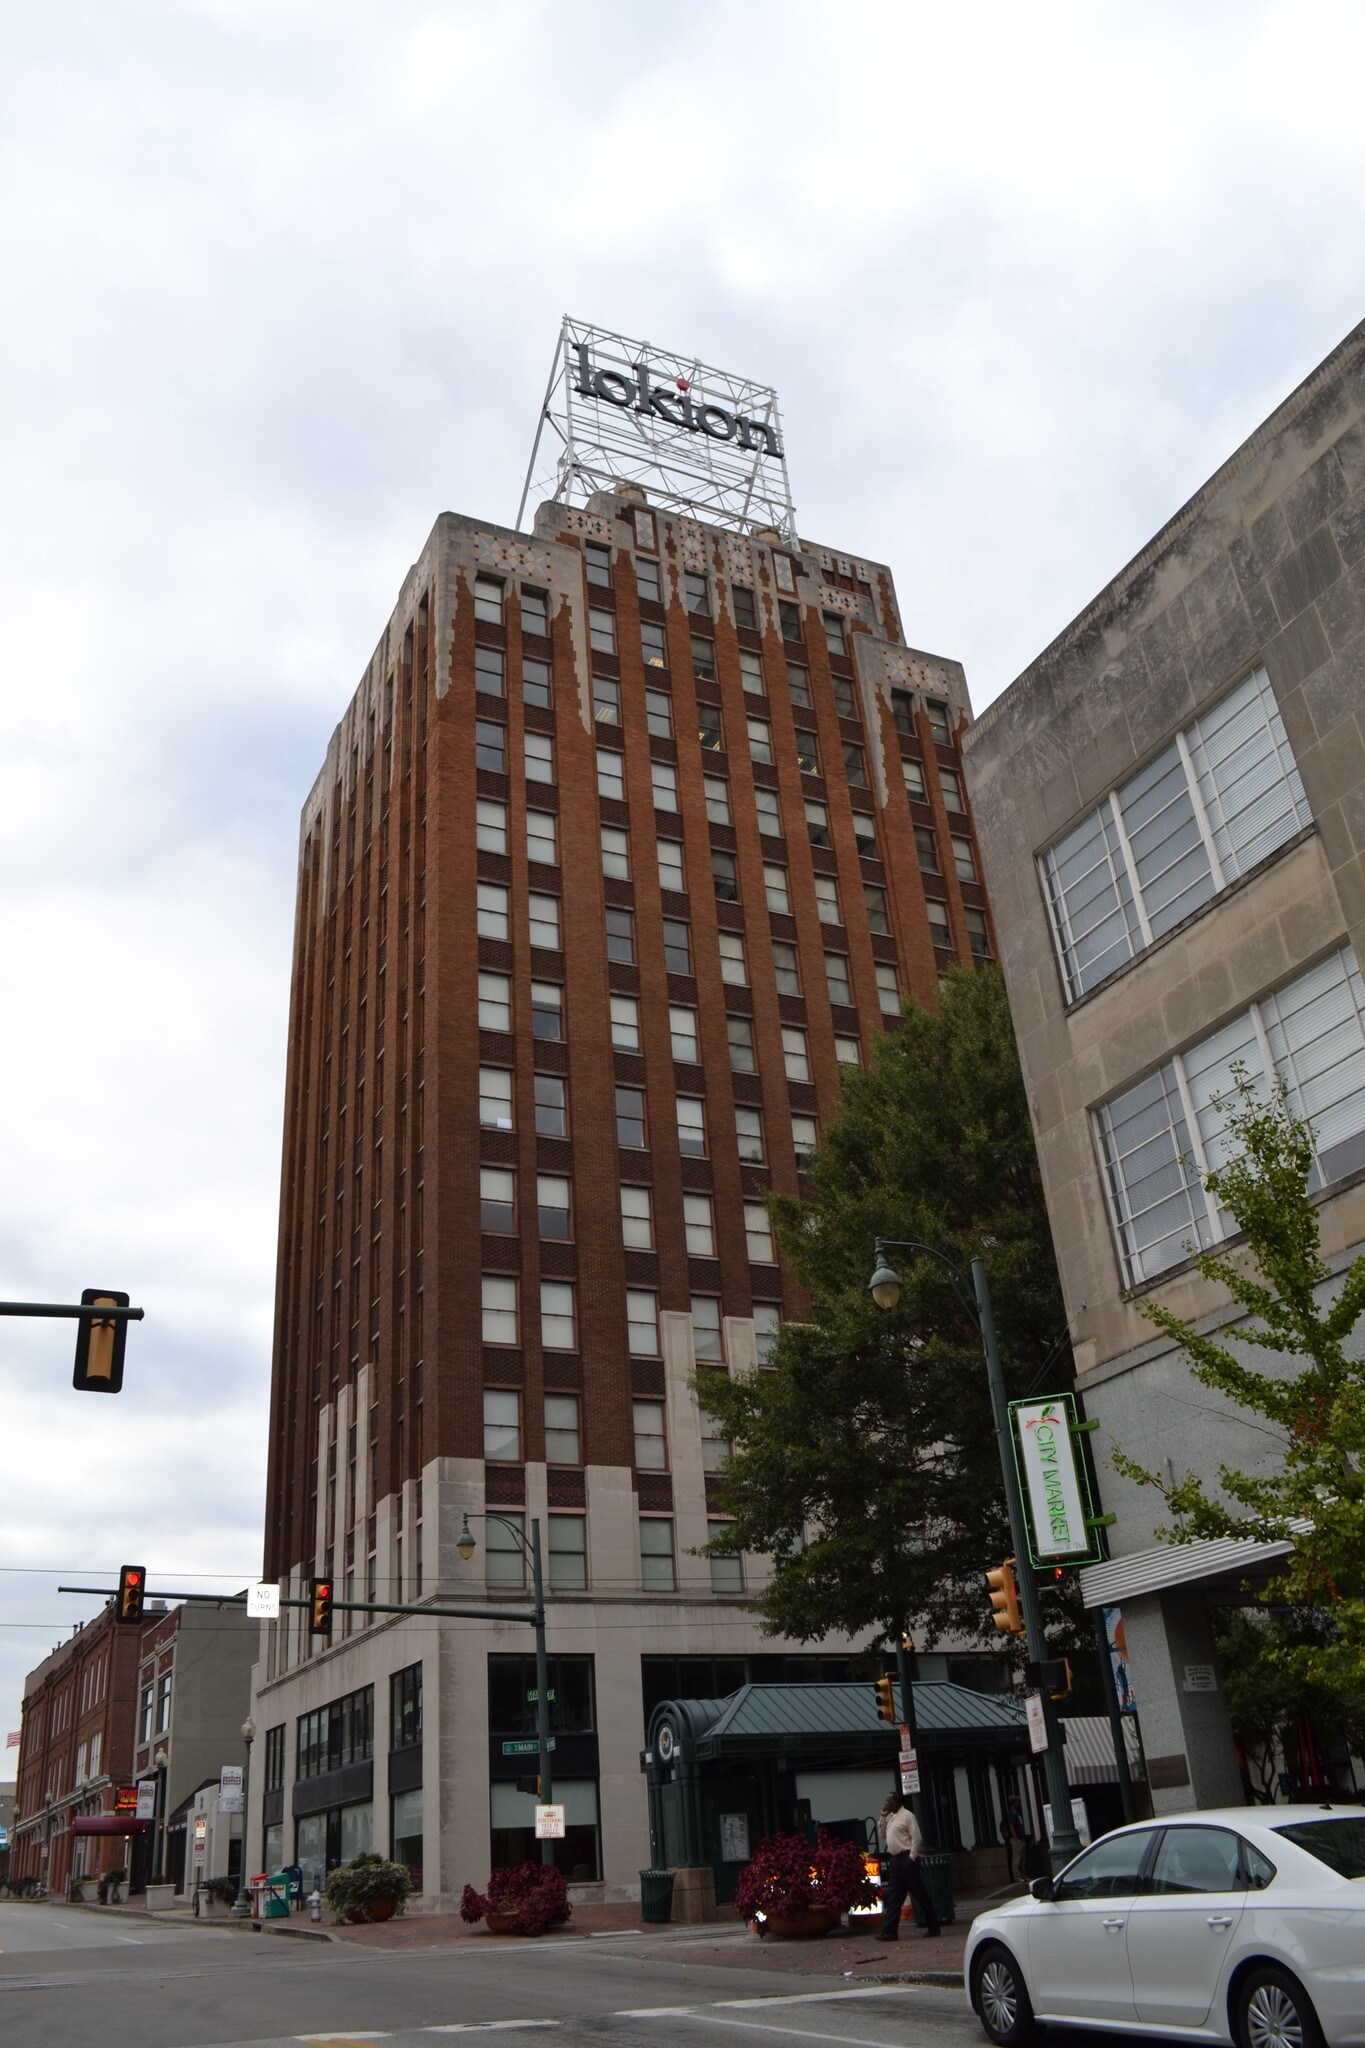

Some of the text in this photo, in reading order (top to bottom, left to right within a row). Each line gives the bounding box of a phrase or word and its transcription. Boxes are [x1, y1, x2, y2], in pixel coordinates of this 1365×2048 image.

[572, 344, 784, 459] lokion
[1034, 1425, 1072, 1543] CITY MARKET
[257, 1590, 270, 1600] NO
[250, 1603, 277, 1612] TURNS
[518, 1744, 533, 1752] MAIN
